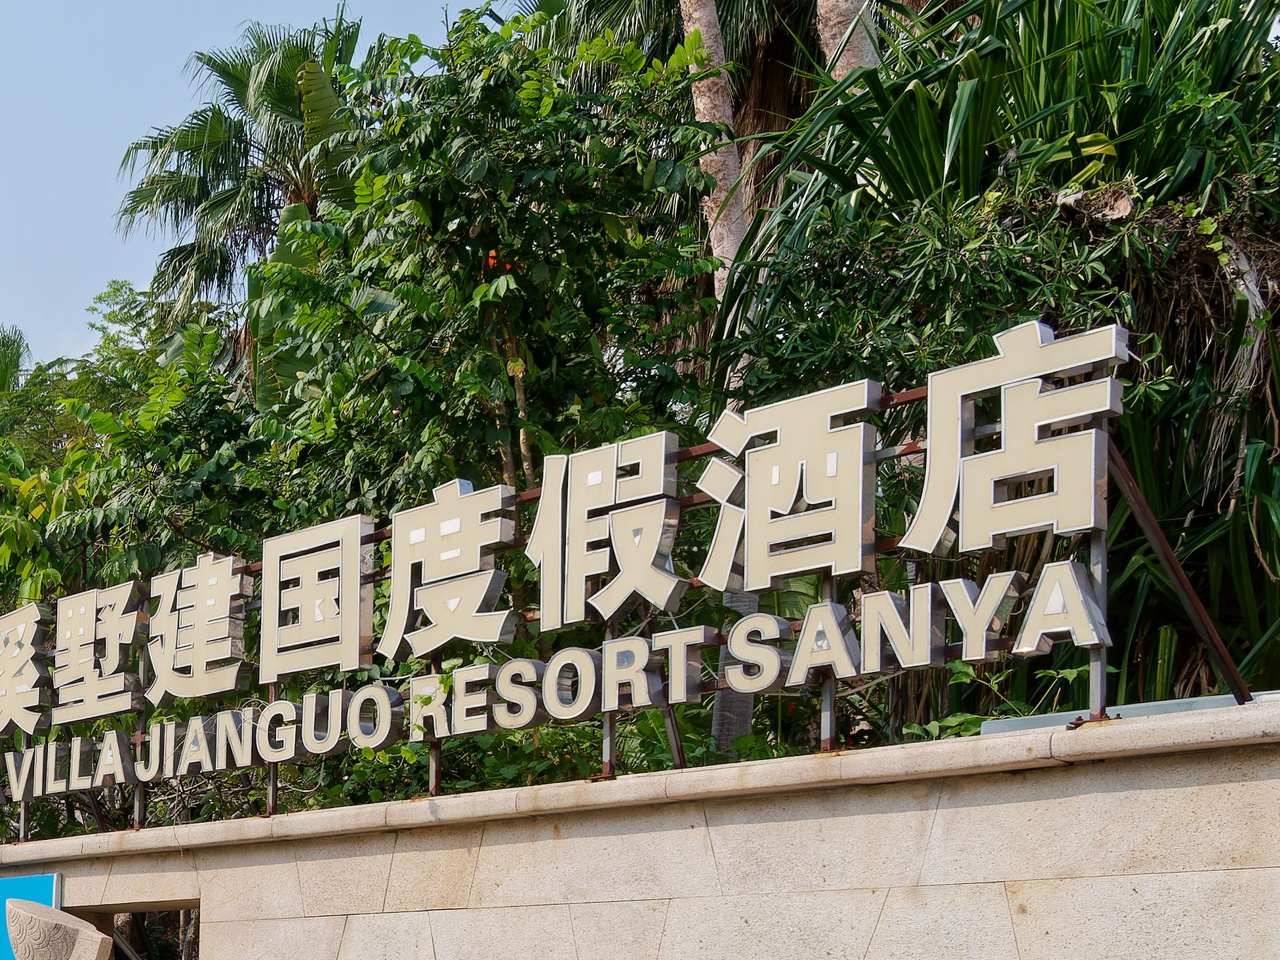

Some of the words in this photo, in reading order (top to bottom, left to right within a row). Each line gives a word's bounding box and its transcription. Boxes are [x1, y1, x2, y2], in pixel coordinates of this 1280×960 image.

[4, 730, 125, 802] VILLA
[136, 686, 393, 782] JIANGUO
[410, 626, 706, 743] RESORT
[725, 560, 1105, 694] SANYA
